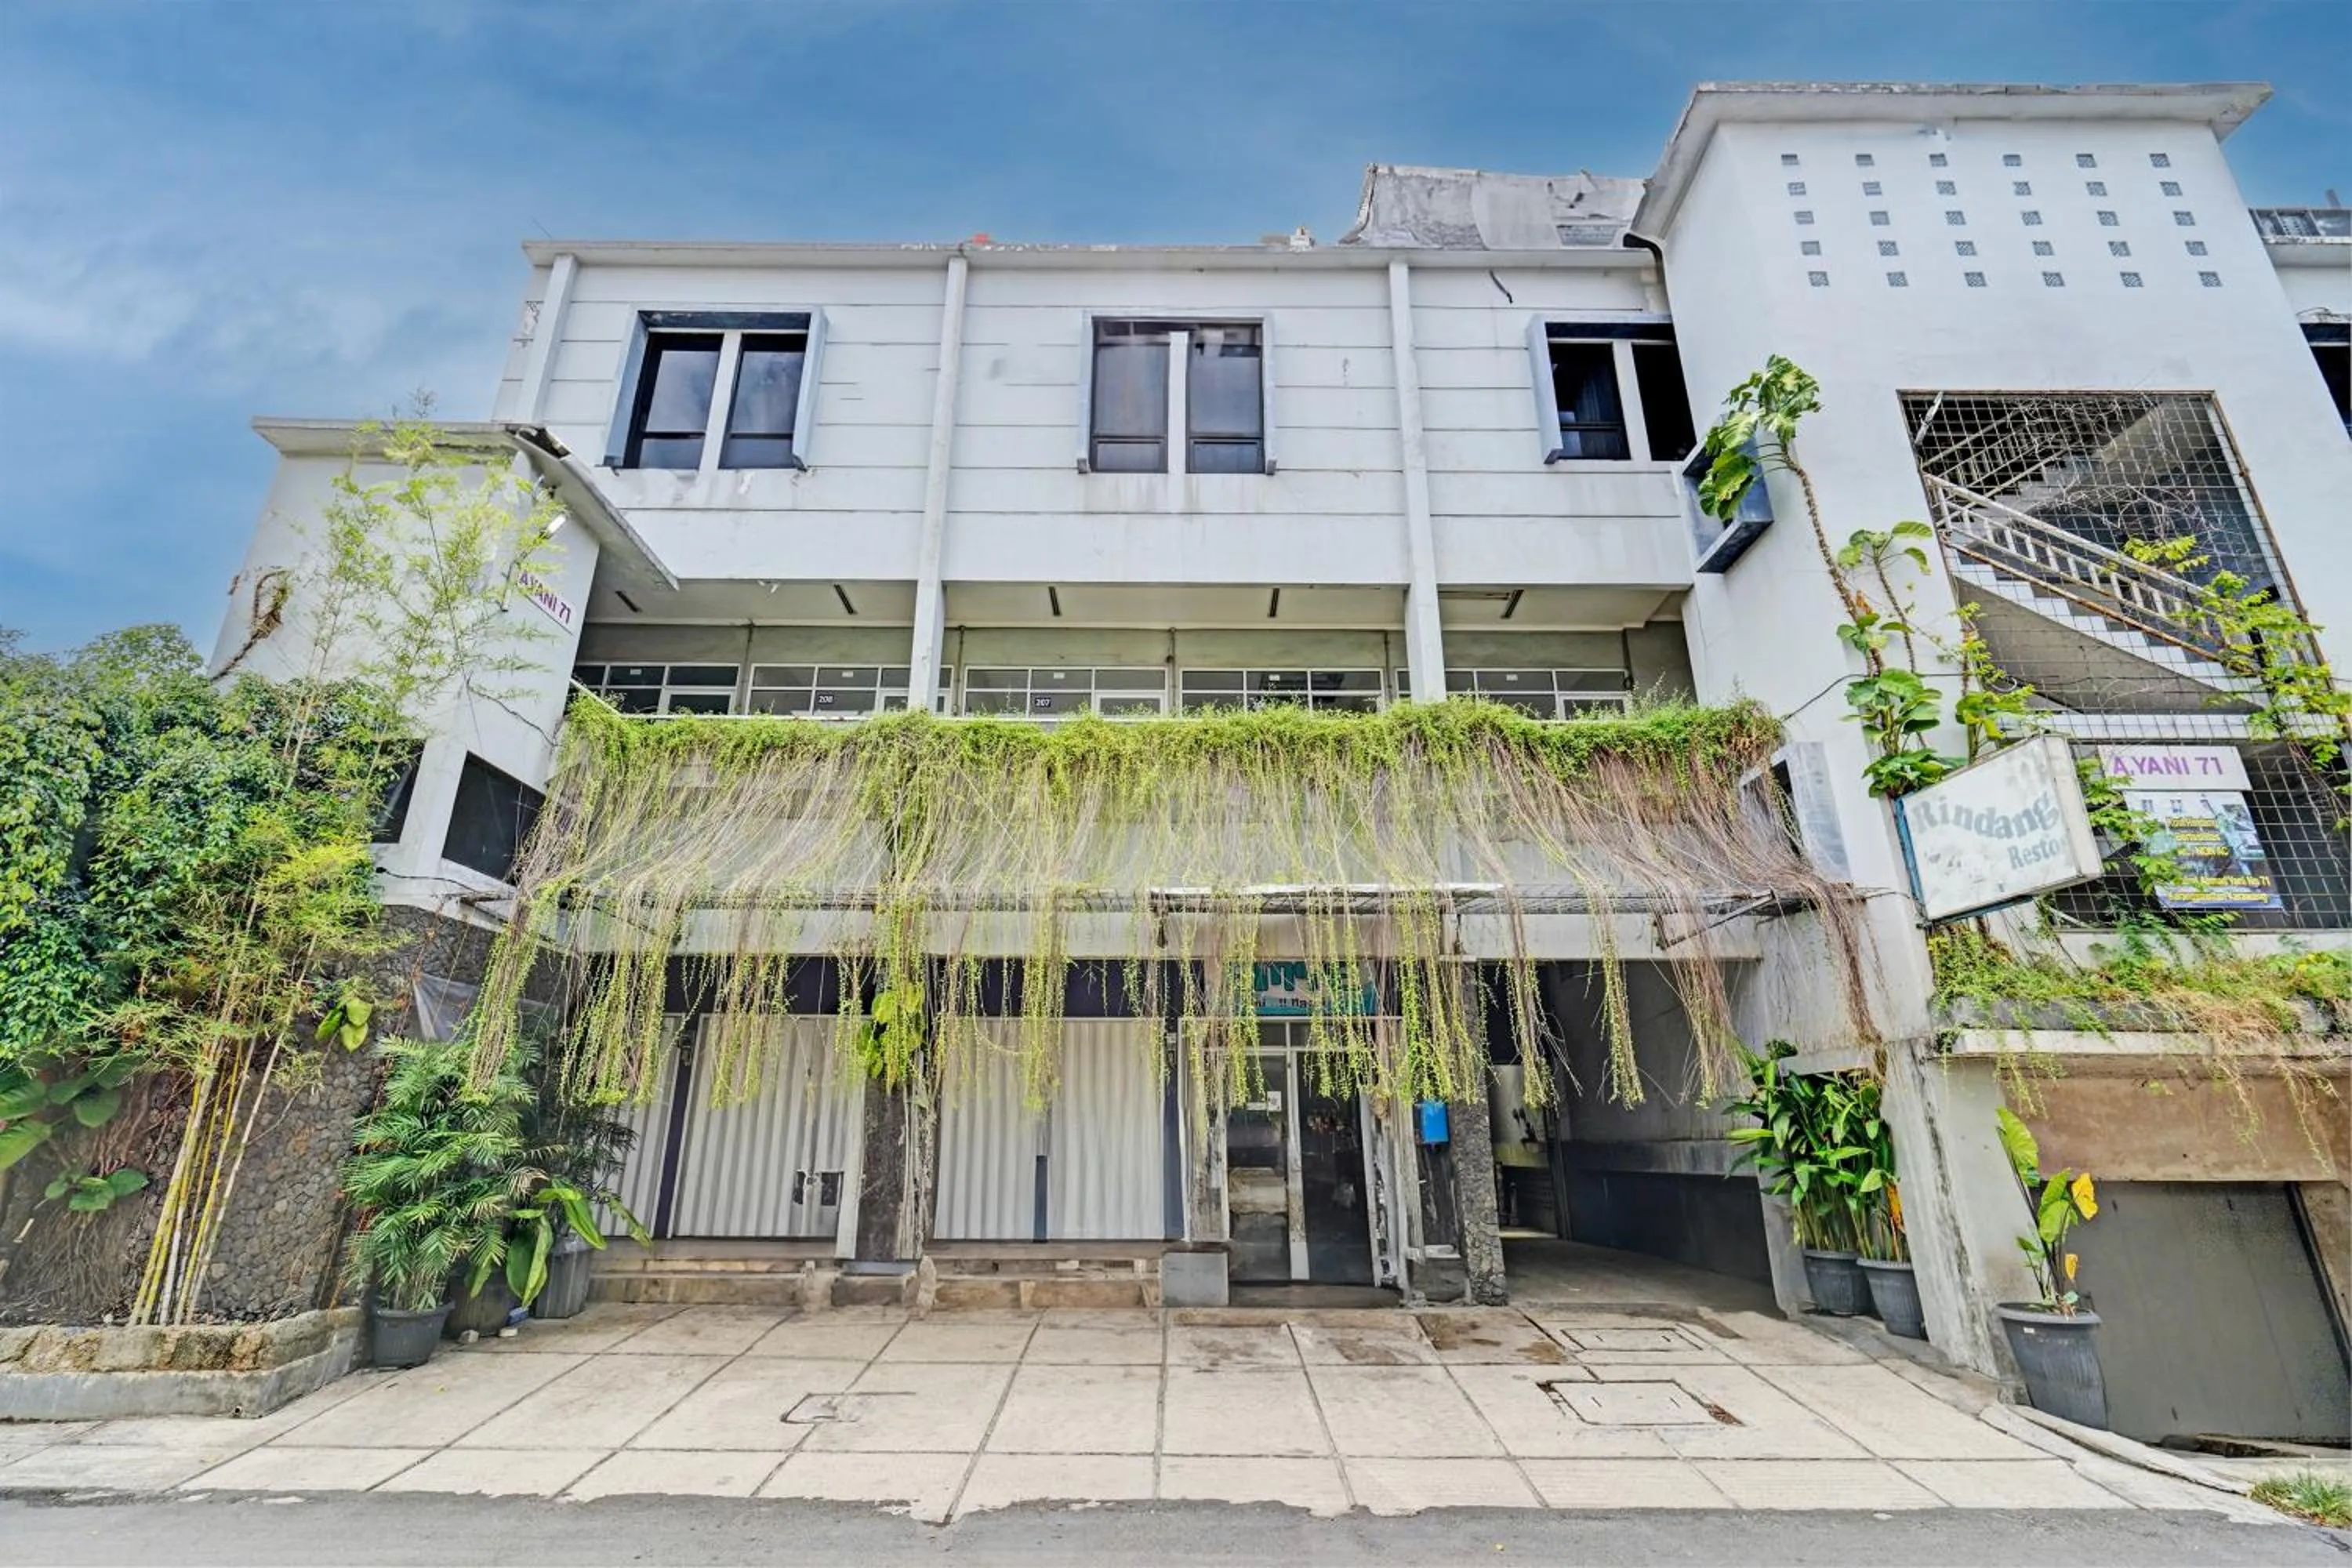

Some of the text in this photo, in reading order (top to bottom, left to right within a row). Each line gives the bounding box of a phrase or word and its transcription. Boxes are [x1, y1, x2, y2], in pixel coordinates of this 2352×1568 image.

[559, 601, 571, 624] 71
[2194, 756, 2223, 775] 71
[1912, 789, 2060, 840] Rindang
